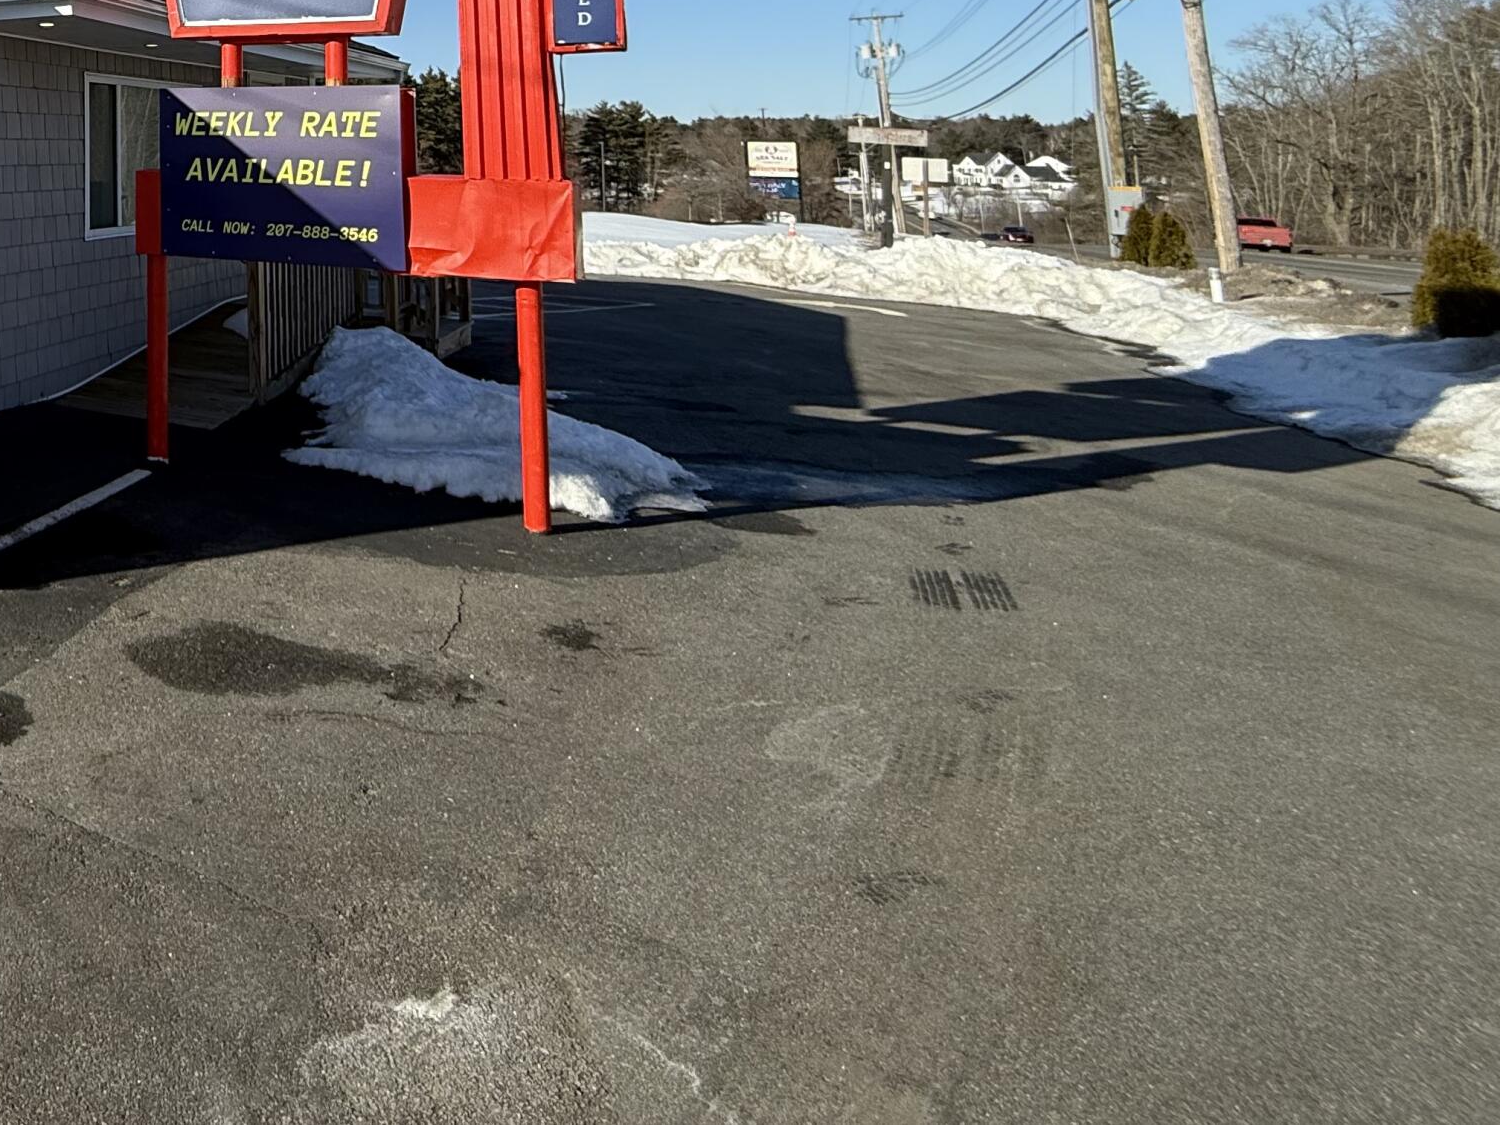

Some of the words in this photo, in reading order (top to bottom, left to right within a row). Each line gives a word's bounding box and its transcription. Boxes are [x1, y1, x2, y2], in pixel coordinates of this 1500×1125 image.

[174, 111, 284, 137] WEEKLY
[300, 111, 381, 138] RATE
[185, 157, 371, 187] AVAILABLE!
[181, 218, 214, 233] CALL
[223, 221, 256, 235] NOW:
[266, 223, 379, 242] 207-888-3546
